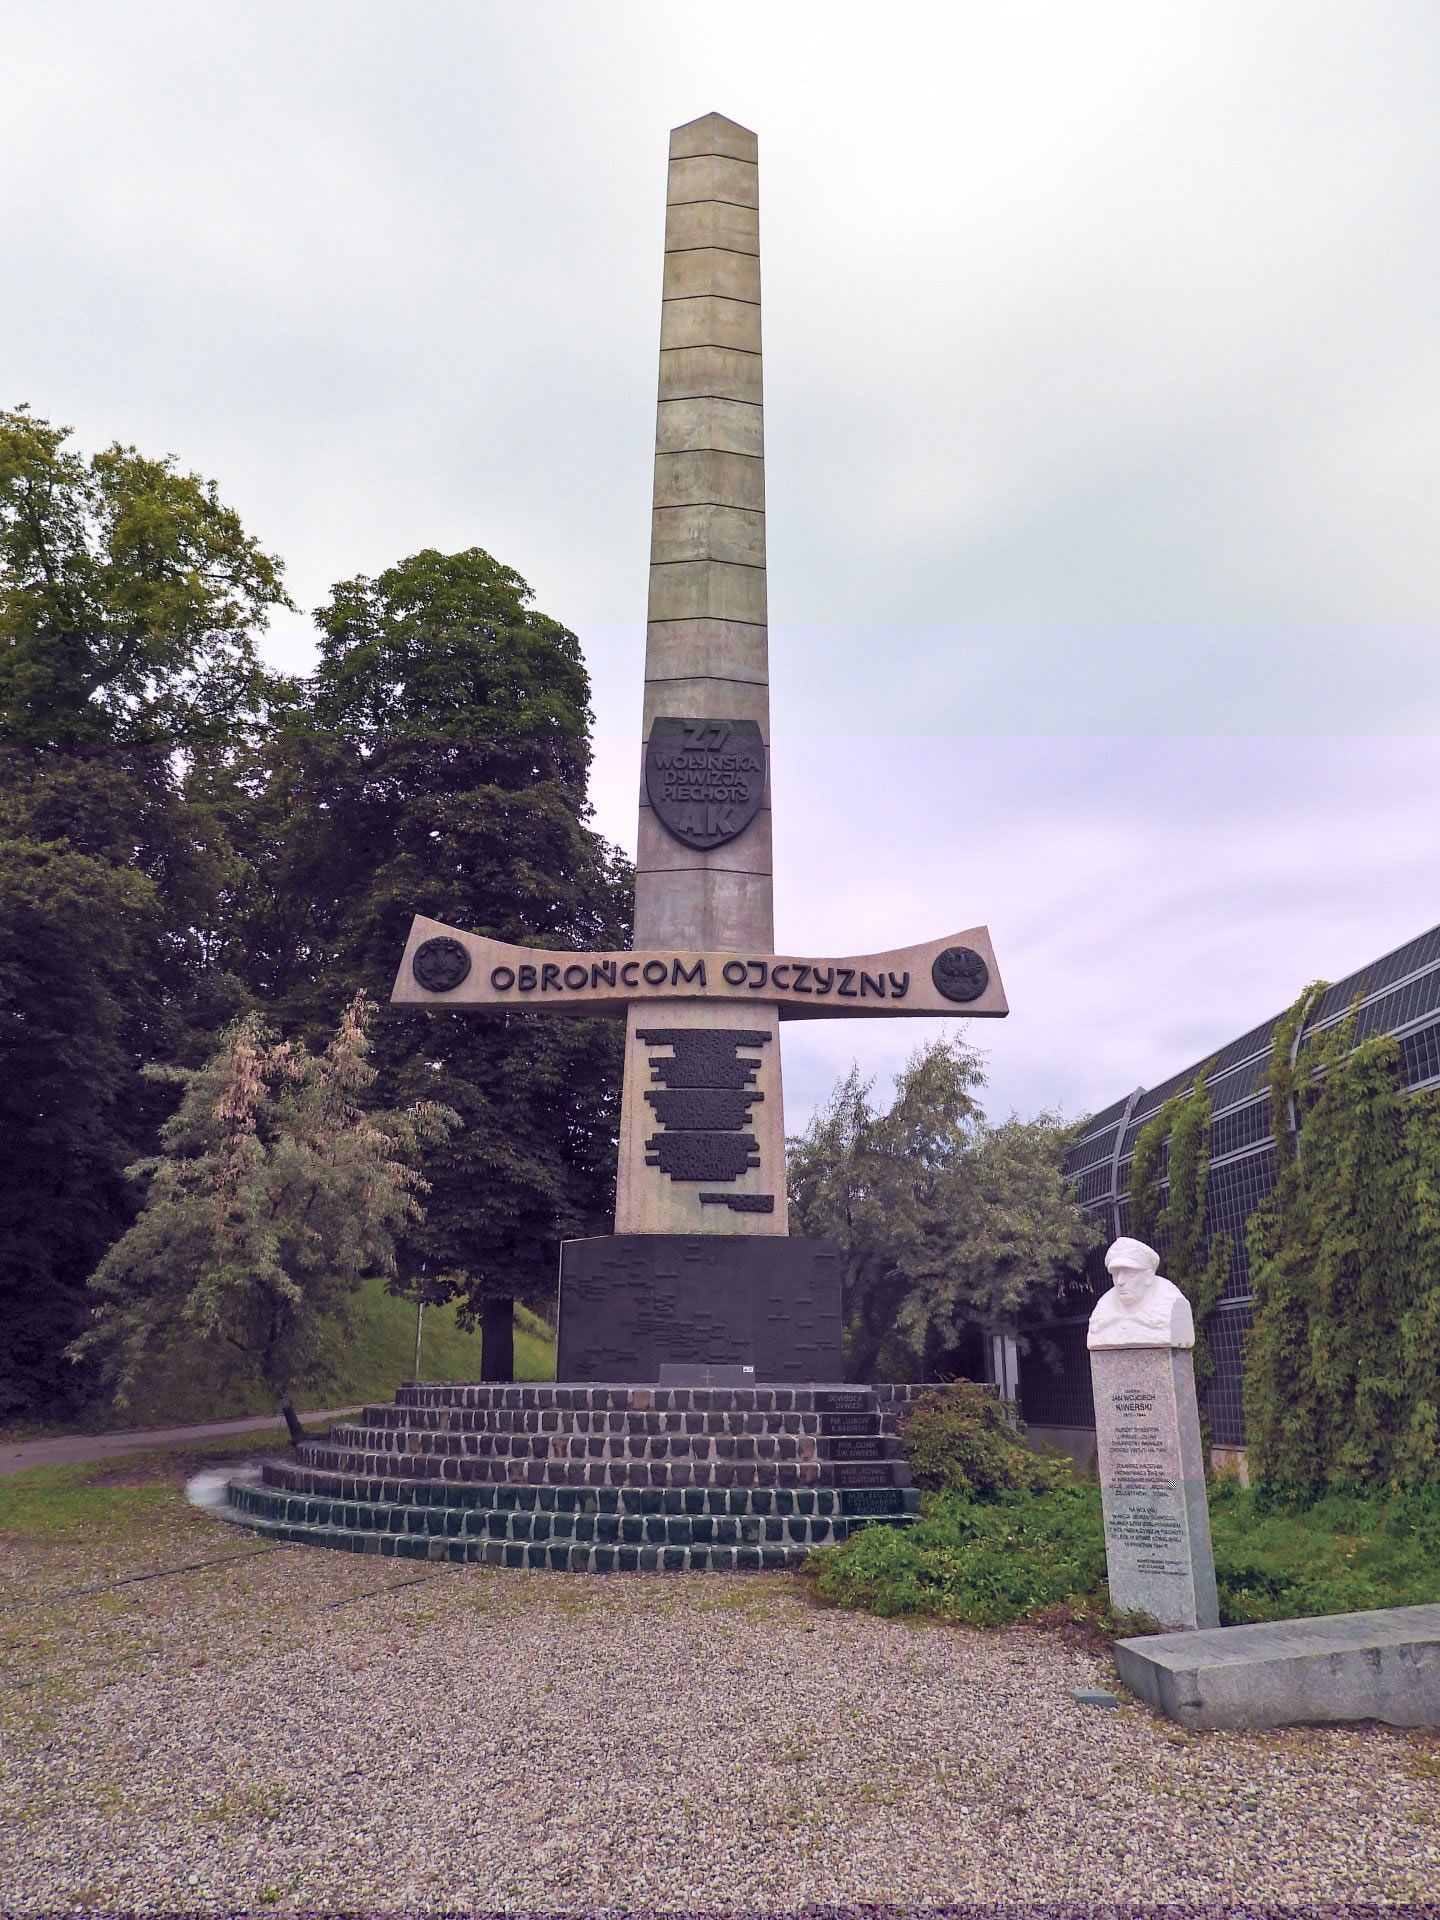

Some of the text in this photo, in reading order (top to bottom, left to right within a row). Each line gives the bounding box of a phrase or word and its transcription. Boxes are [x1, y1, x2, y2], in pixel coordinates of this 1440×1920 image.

[683, 721, 732, 751] 27
[664, 770, 747, 787] DYWIZJA
[661, 786, 750, 802] PIECHOTY
[678, 806, 735, 835] AK
[491, 957, 910, 998] OBROŃCOM OJCZYZNY
[1115, 1403, 1153, 1411] KIWERSKI
